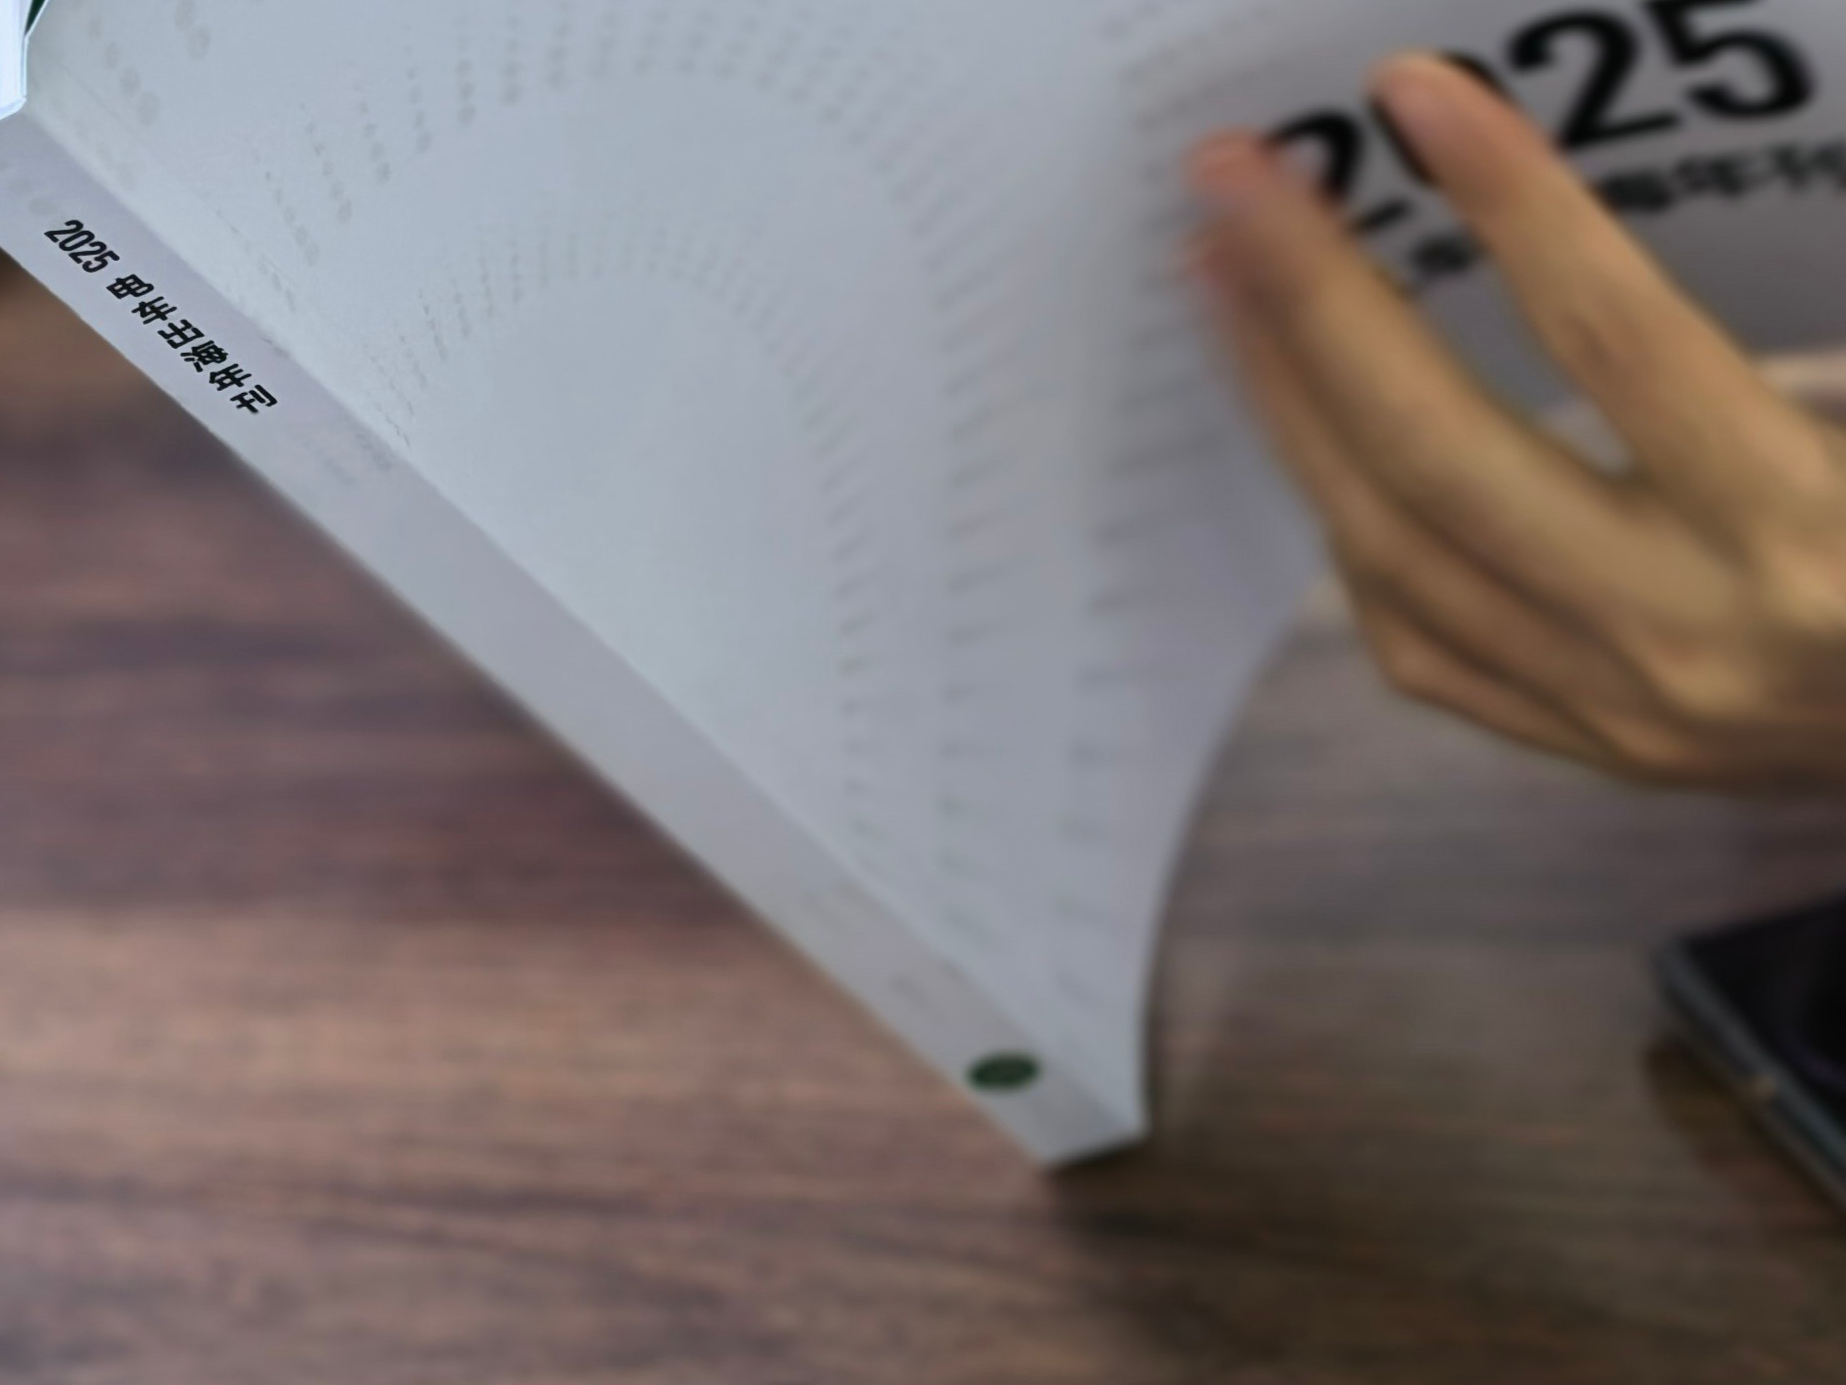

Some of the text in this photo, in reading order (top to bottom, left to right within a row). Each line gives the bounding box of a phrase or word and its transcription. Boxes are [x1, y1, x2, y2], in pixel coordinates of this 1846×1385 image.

[44, 219, 278, 414] 2025 电车出海年刊
